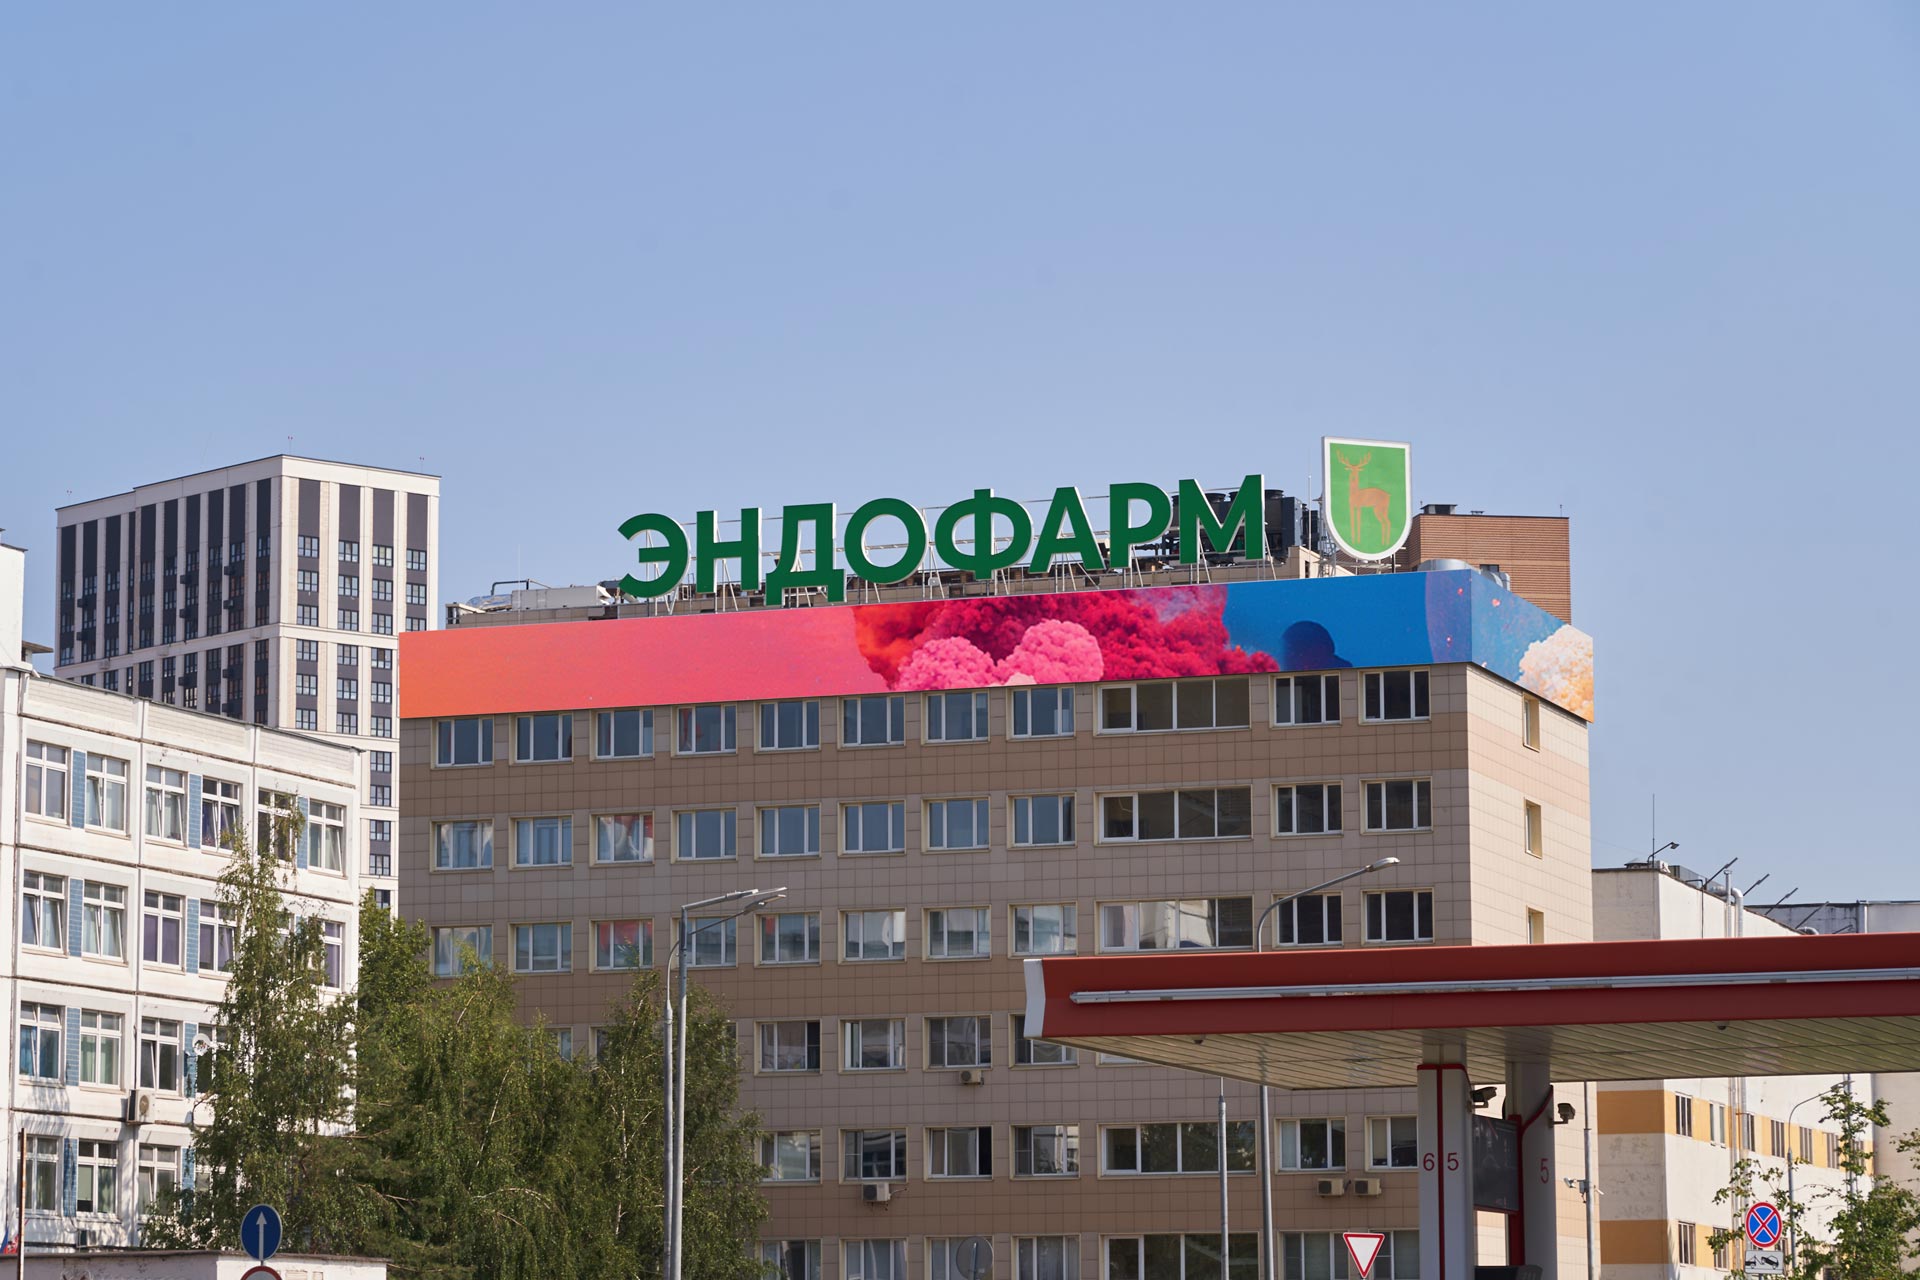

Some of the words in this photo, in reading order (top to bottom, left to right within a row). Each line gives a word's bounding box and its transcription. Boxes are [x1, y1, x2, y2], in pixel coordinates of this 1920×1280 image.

[618, 474, 1265, 606] ЭНДОФАРМ
[1423, 1153, 1435, 1171] 6
[1447, 1152, 1459, 1171] 5
[1540, 1158, 1549, 1184] 5
